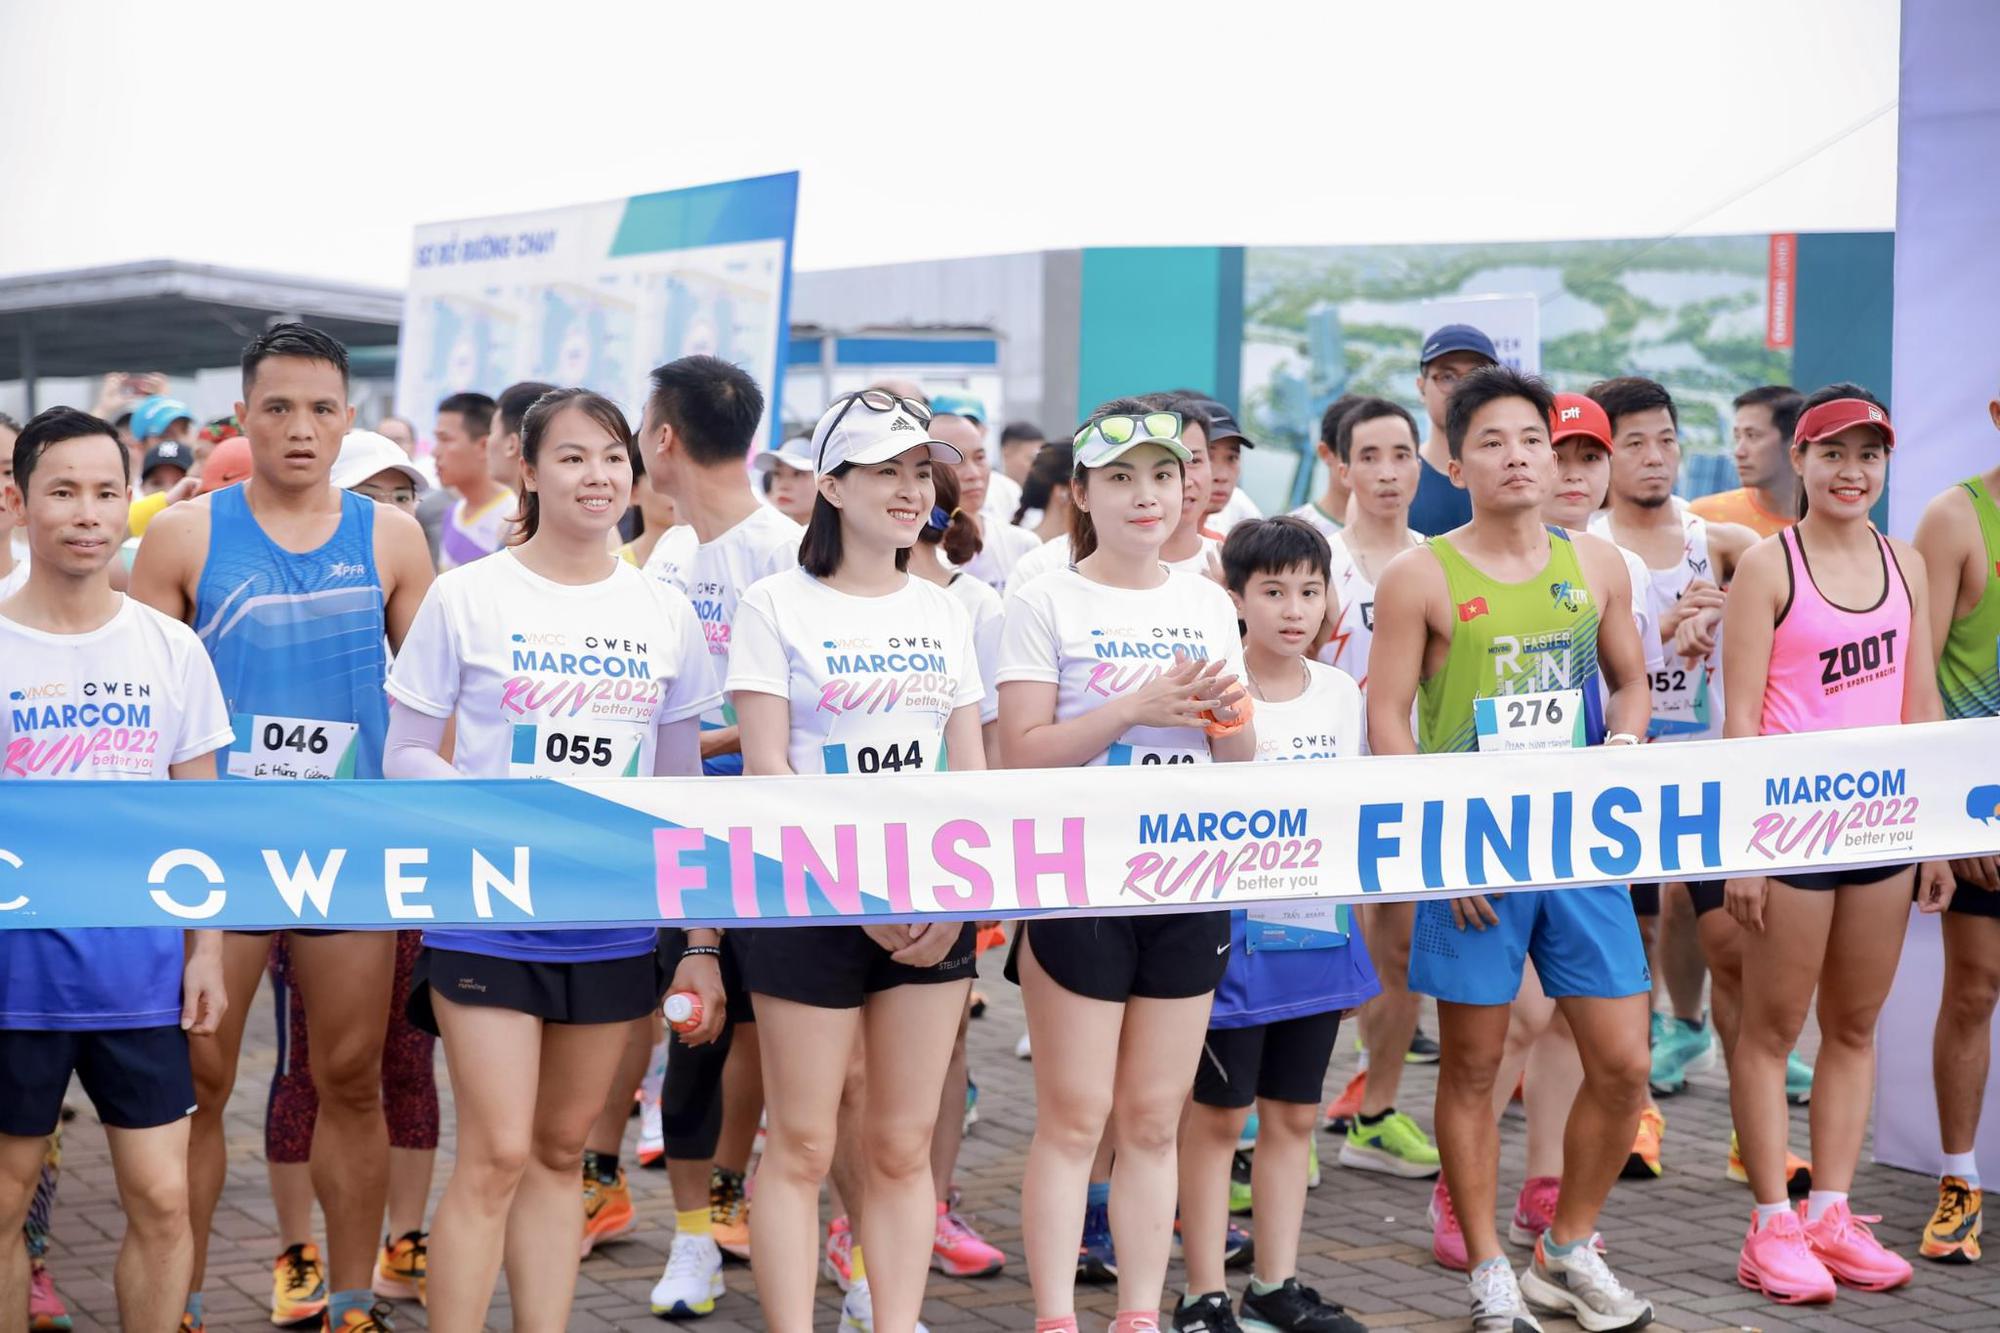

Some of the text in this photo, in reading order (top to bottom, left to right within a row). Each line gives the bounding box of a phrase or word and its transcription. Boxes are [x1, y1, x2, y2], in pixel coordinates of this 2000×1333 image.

[697, 582, 725, 596] OWEN
[585, 636, 648, 655] OWEN
[889, 637, 942, 650] OWEN
[1152, 627, 1204, 640] OWEN
[512, 650, 651, 680] MARCOM
[826, 653, 948, 676] MARCOM
[1819, 629, 1897, 685] ZOOT
[84, 682, 151, 698] OWEN
[1825, 684, 1844, 696] ZOOT
[12, 702, 151, 733] MARCOM
[591, 702, 634, 718] better
[1507, 698, 1563, 729] 276
[263, 722, 329, 754] 046
[546, 732, 612, 767] 055
[1292, 734, 1337, 749] OWEN
[857, 740, 923, 774] 044
[1766, 768, 1906, 807] MARCOM
[1138, 808, 1308, 845] MARCOM
[1357, 780, 1722, 894] FINISH
[1844, 829, 1914, 847] better you
[147, 847, 535, 920] OWEN
[653, 817, 1089, 920] FINISH
[1237, 874, 1319, 892] better you
